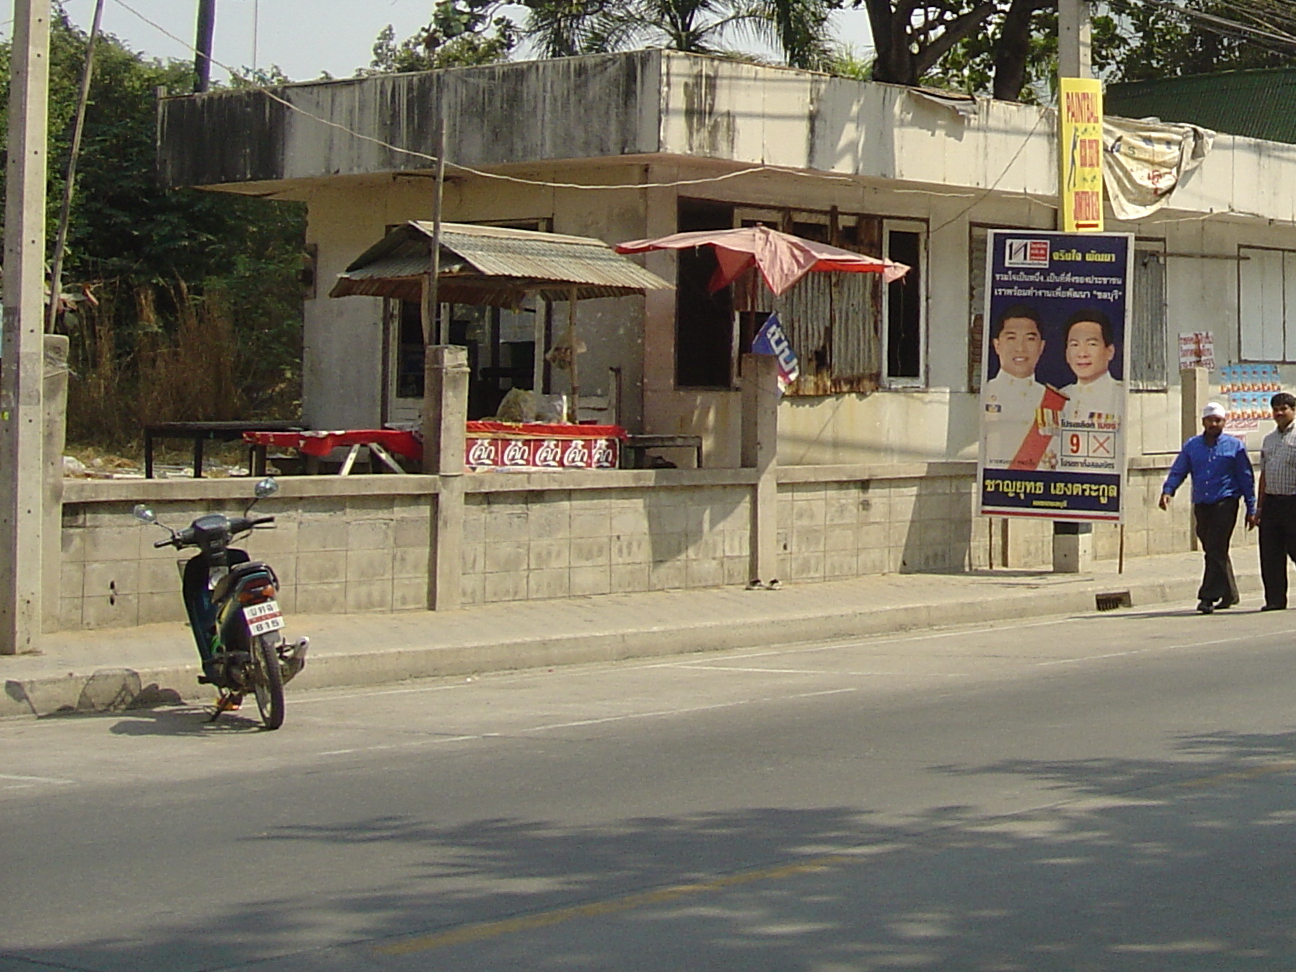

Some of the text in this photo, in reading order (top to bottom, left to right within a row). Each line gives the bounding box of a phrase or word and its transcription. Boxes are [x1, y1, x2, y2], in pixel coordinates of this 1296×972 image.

[1069, 433, 1080, 454] 9
[984, 479, 1118, 504] ชาญยุทธ เฮงตระกูล
[255, 618, 281, 632] 815
